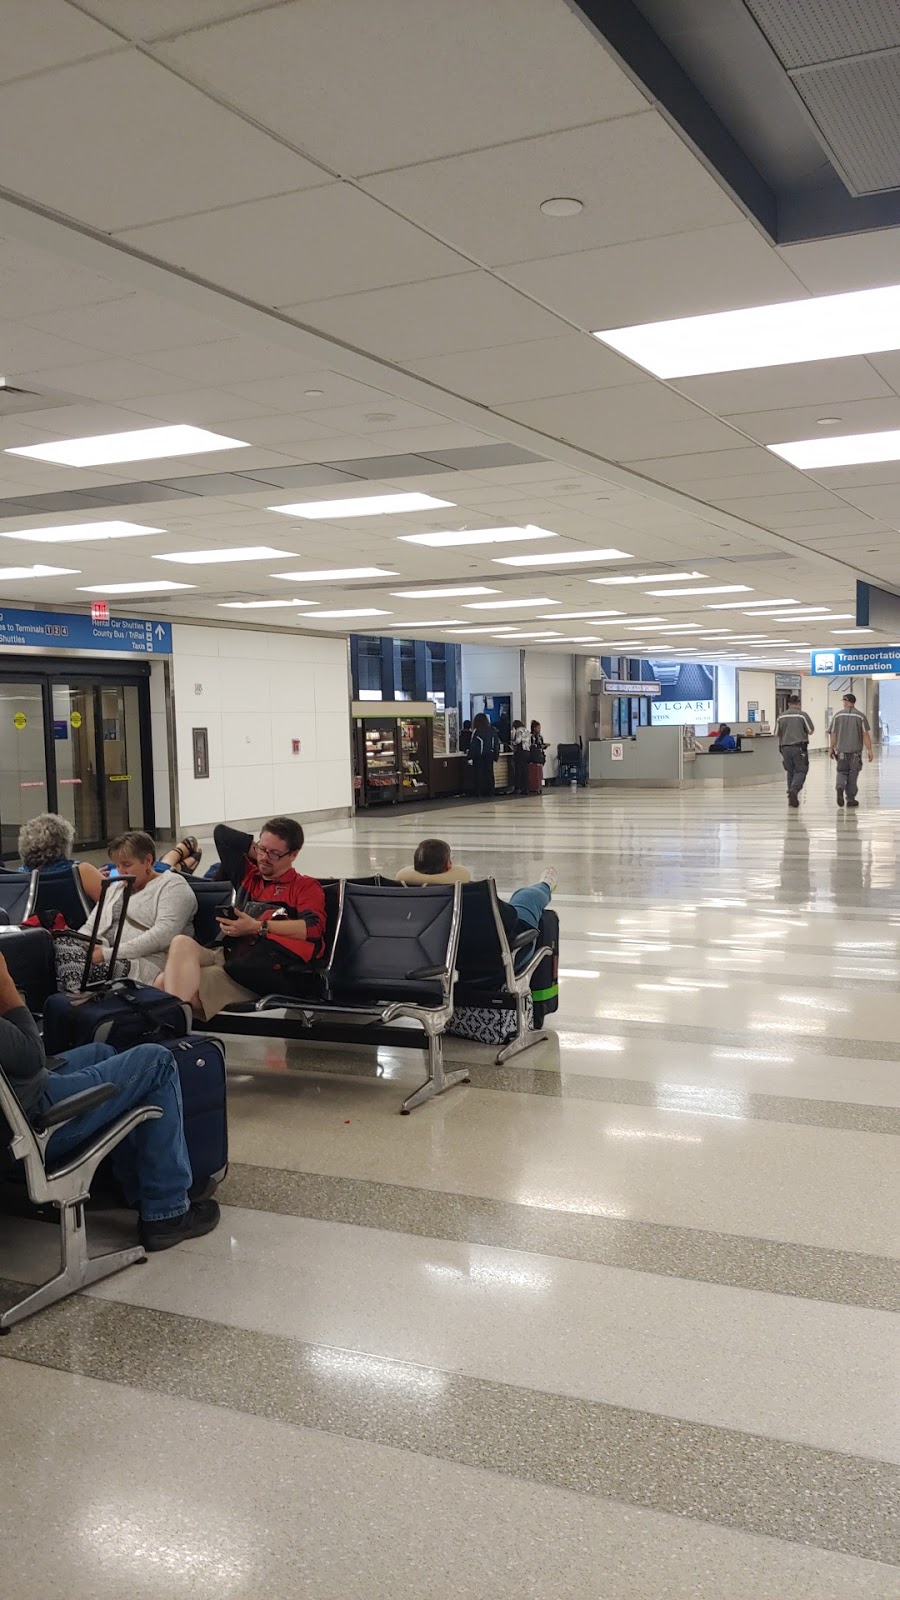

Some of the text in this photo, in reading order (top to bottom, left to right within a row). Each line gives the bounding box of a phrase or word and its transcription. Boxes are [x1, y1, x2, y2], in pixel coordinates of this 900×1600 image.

[15, 624, 45, 634] Terminals
[122, 621, 144, 630] Shuttles
[93, 629, 113, 639] County
[114, 631, 124, 639] Bus
[838, 662, 892, 671] Information
